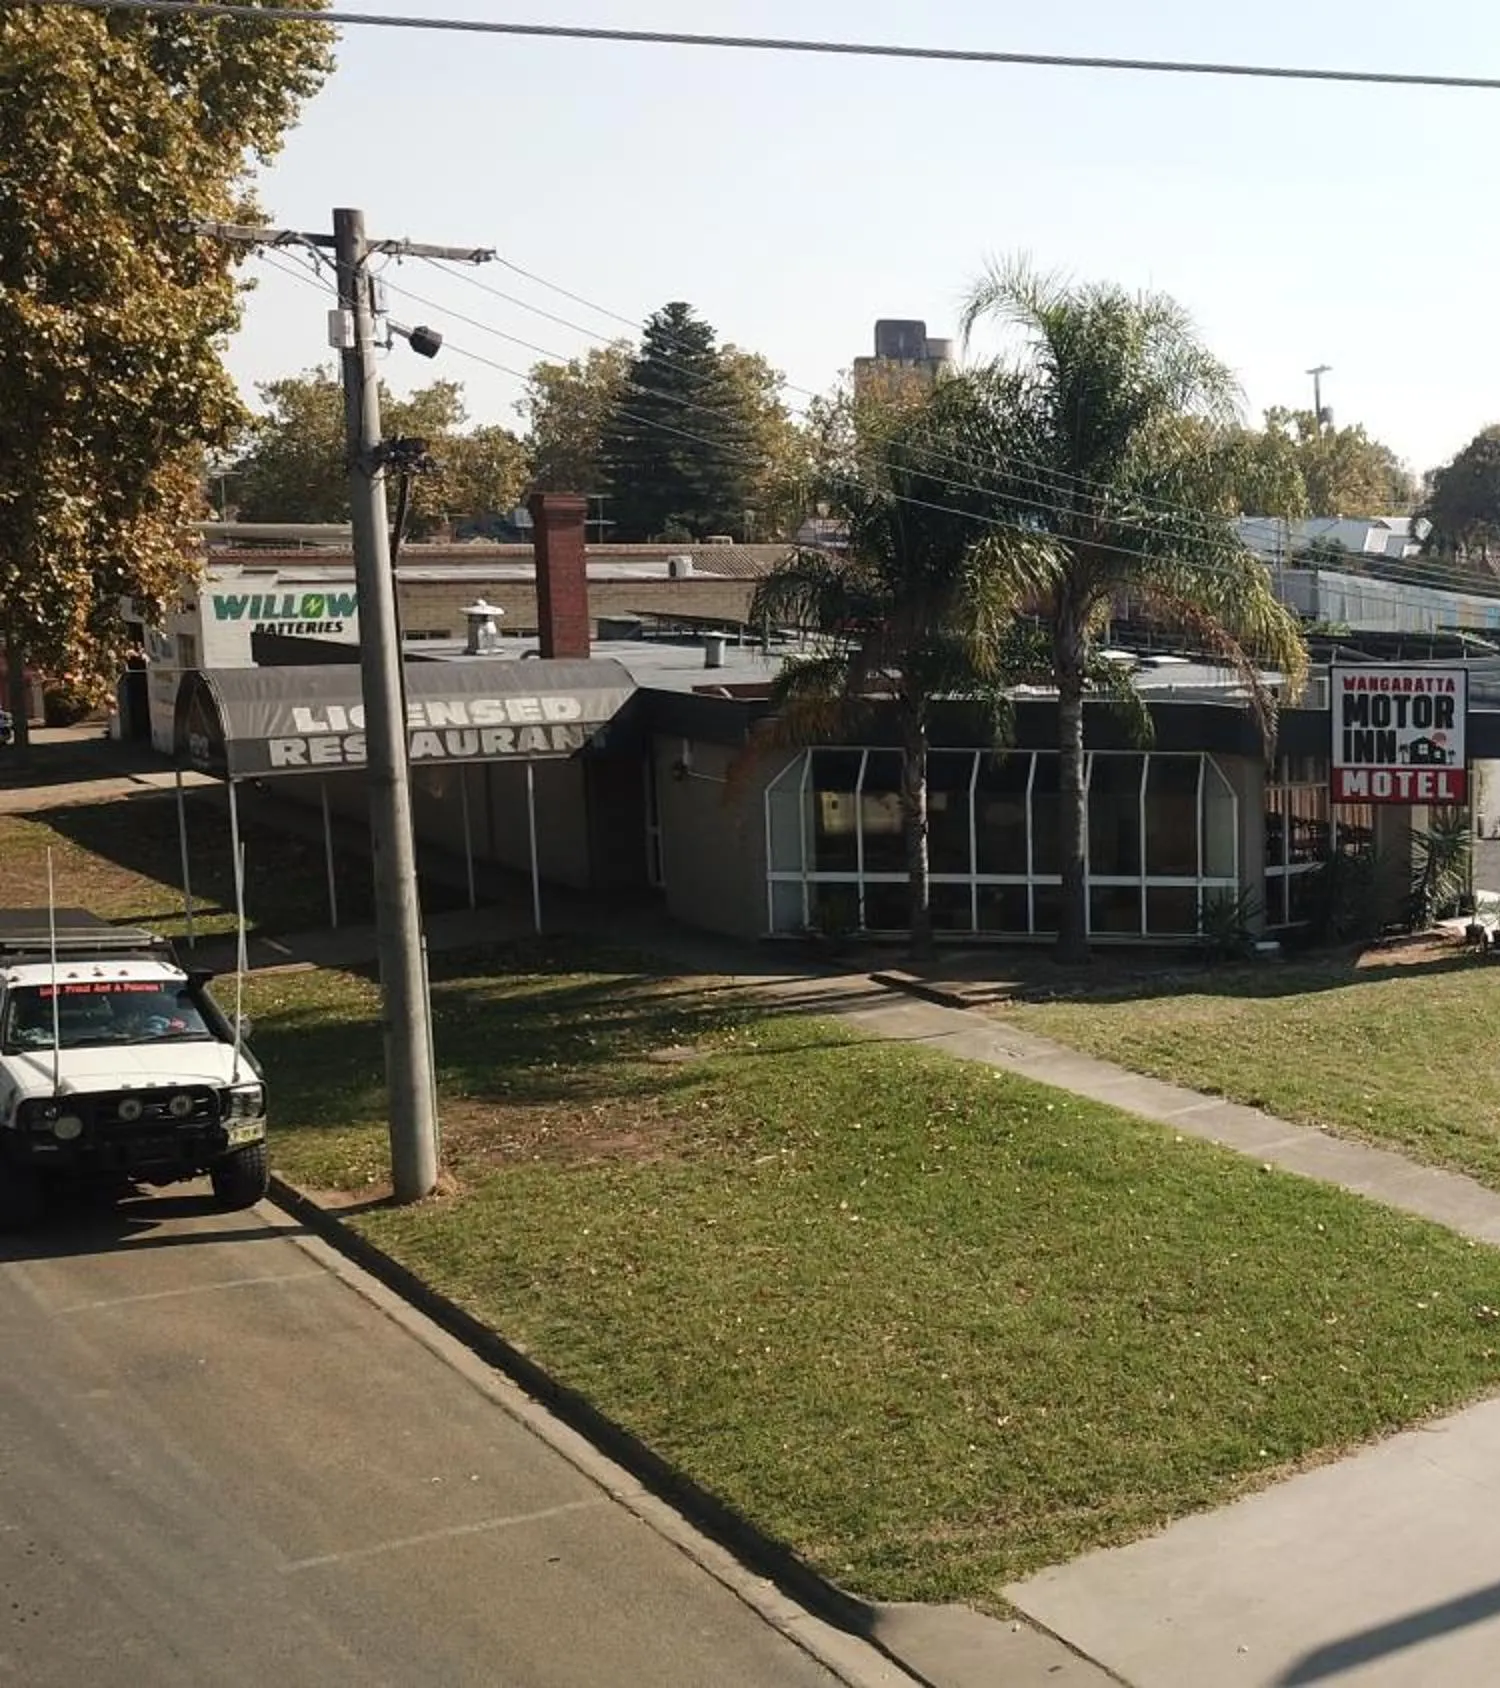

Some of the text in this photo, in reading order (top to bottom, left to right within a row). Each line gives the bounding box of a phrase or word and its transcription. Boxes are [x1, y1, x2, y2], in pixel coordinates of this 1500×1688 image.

[211, 593, 358, 620] WILLOW
[254, 621, 344, 635] BATTERIES
[1342, 676, 1456, 692] WANGARATTA
[1342, 693, 1455, 729] MOTOR
[269, 723, 608, 767] RESAURANT
[1343, 729, 1397, 764] INN
[1342, 770, 1455, 799] MOTEL
